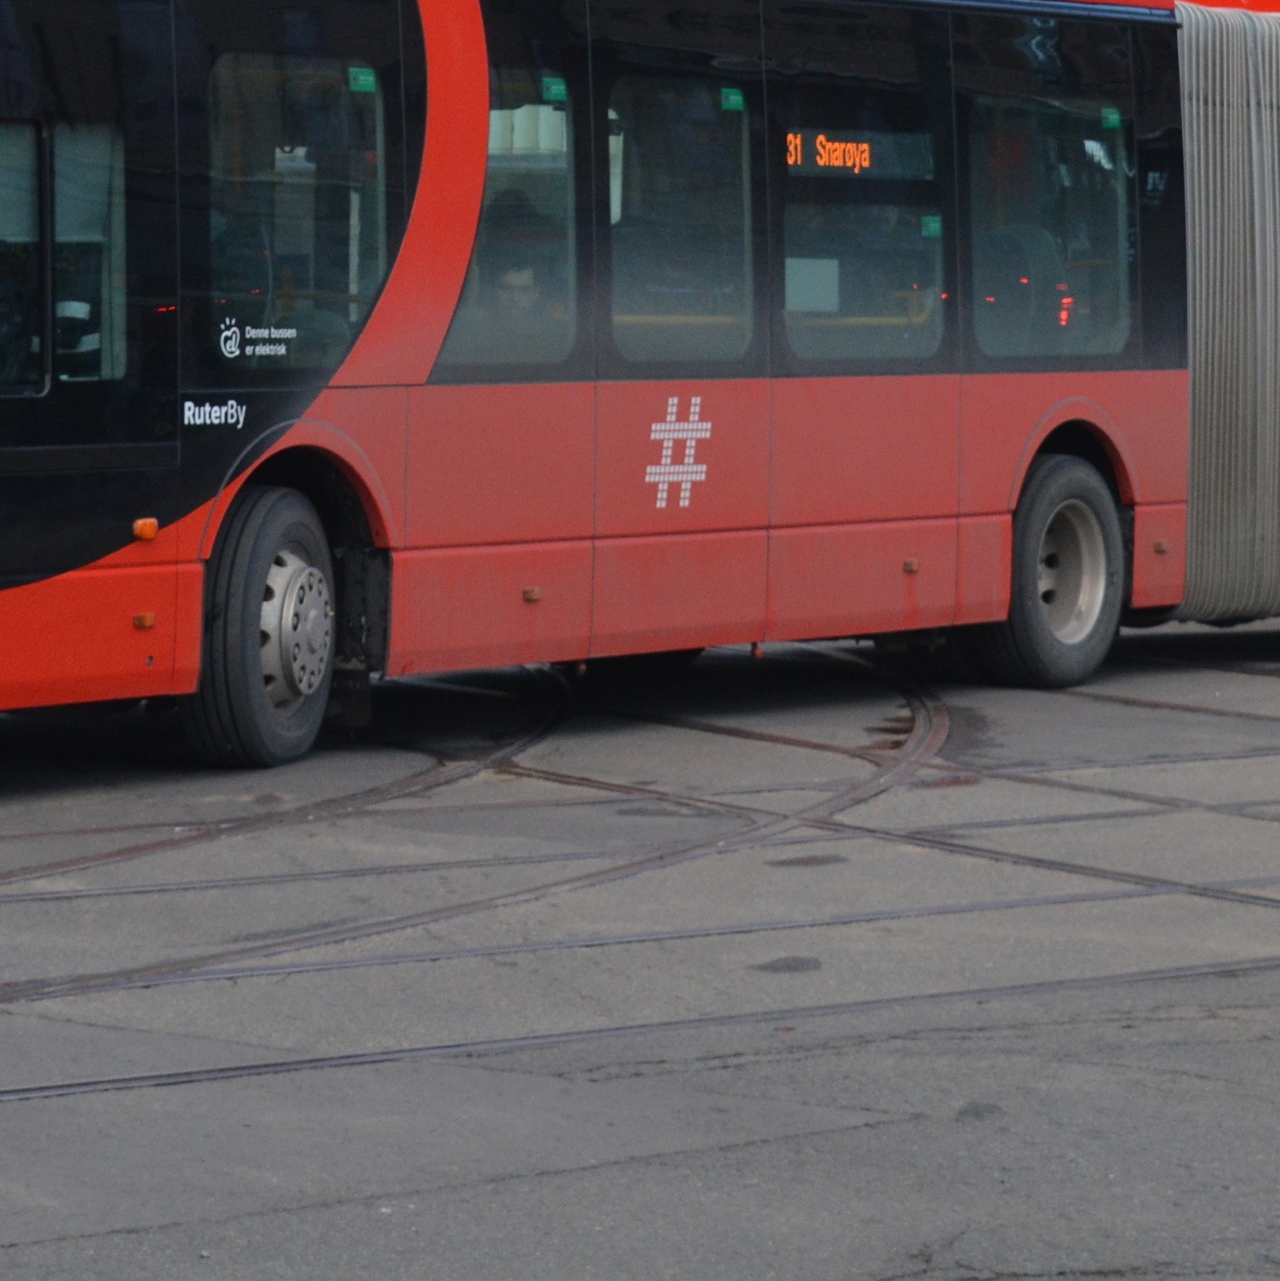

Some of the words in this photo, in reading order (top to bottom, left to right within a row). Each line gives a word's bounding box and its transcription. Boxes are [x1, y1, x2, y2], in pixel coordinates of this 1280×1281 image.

[786, 132, 803, 166] 31
[245, 326, 269, 339] Denne
[270, 326, 297, 339] bussen
[255, 343, 287, 356] elektrisk
[184, 400, 246, 429] RuterBy
